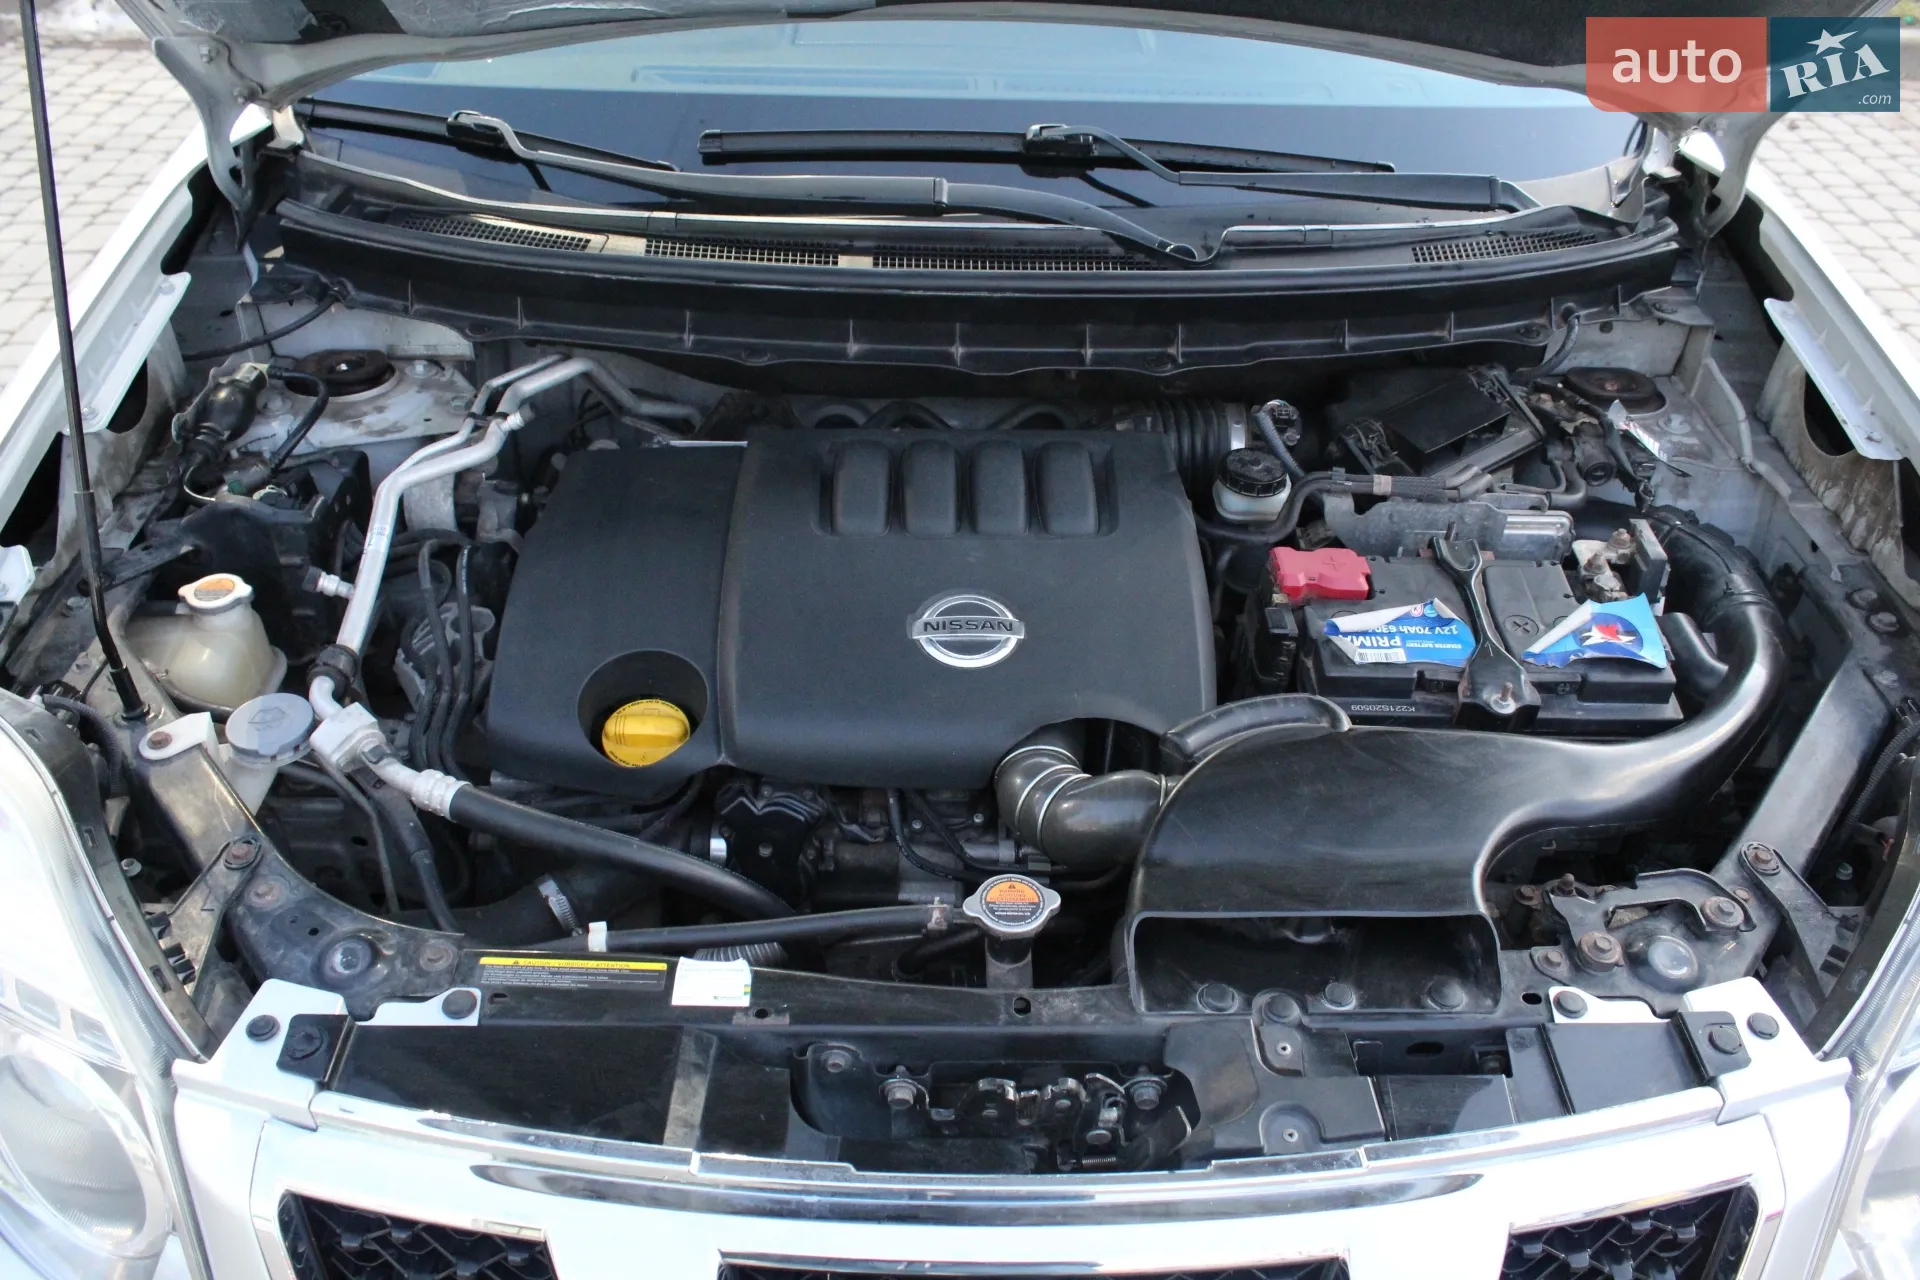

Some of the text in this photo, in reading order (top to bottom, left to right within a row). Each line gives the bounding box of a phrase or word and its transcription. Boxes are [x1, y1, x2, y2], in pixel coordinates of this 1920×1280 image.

[923, 620, 1013, 632] NISSAN
[1399, 625, 1432, 635] 70Ah
[1435, 624, 1459, 635] 12V
